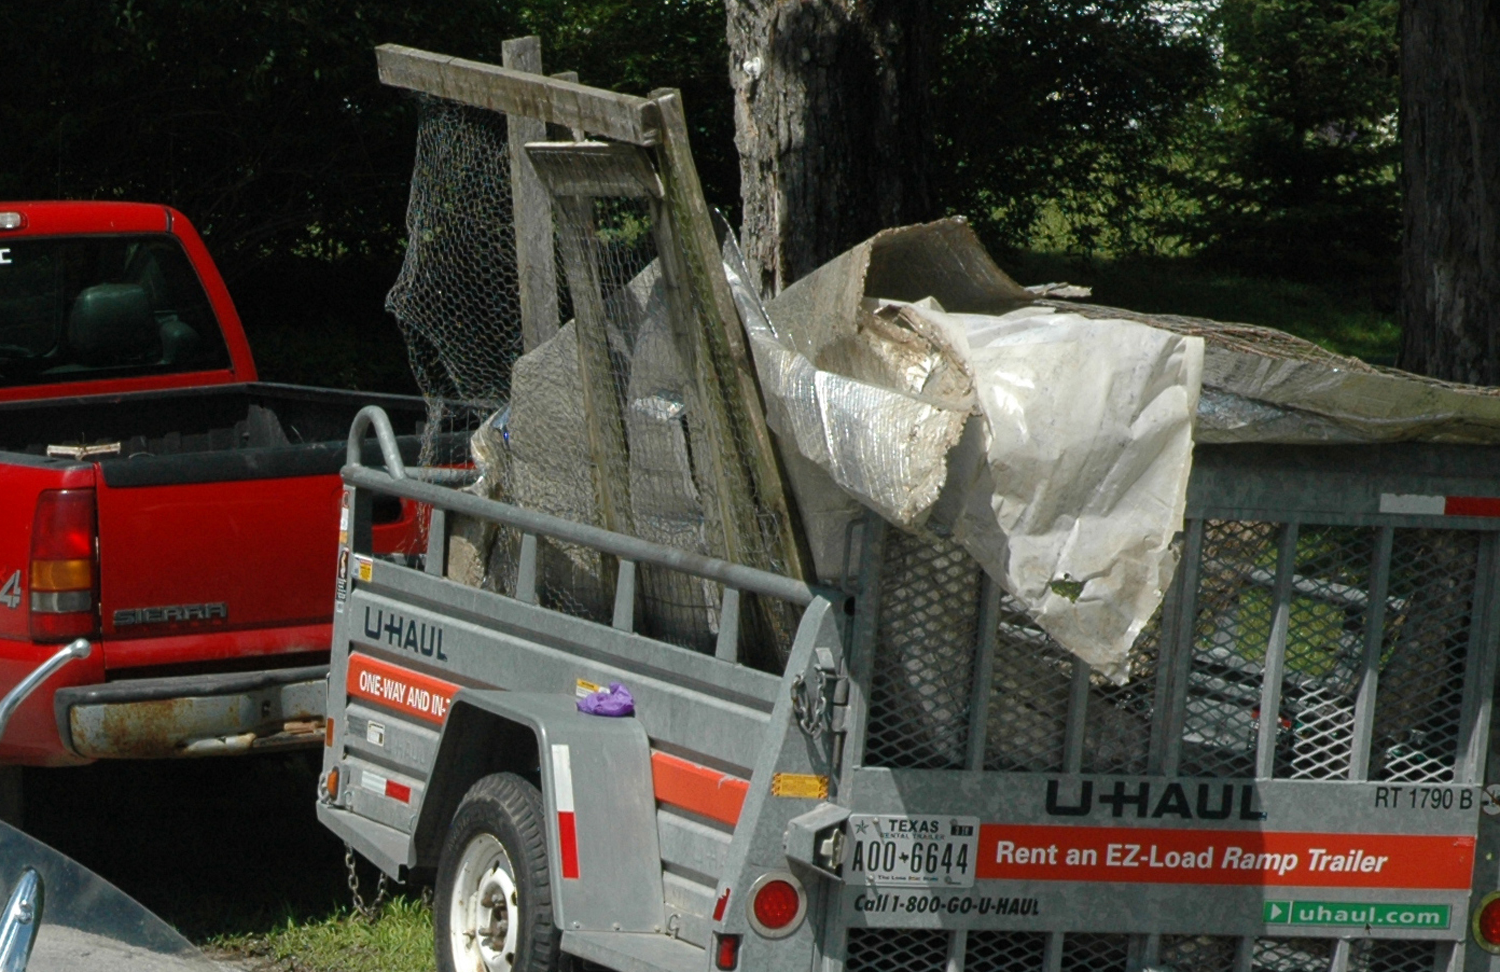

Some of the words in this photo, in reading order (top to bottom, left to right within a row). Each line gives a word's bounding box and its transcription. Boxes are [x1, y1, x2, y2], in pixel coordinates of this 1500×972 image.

[112, 602, 229, 627] SIERRA
[364, 606, 448, 662] U-HAUL
[358, 670, 407, 704] ONE-WAY
[406, 686, 430, 712] AND
[1045, 779, 1267, 821] U-HAUL
[1374, 787, 1403, 808] RT
[1409, 787, 1454, 810] 1790
[1459, 788, 1474, 810] B
[888, 819, 940, 834] TEXAS
[996, 840, 1058, 866] Rent
[1065, 848, 1098, 867] an
[1106, 843, 1214, 870] EZ-Load
[1221, 846, 1299, 876] Ramp
[1307, 848, 1389, 873] Trailer
[854, 893, 890, 913] Call
[891, 895, 1040, 916] 1-800-GO-U-HAUL
[1298, 906, 1441, 925] uhaul.com
